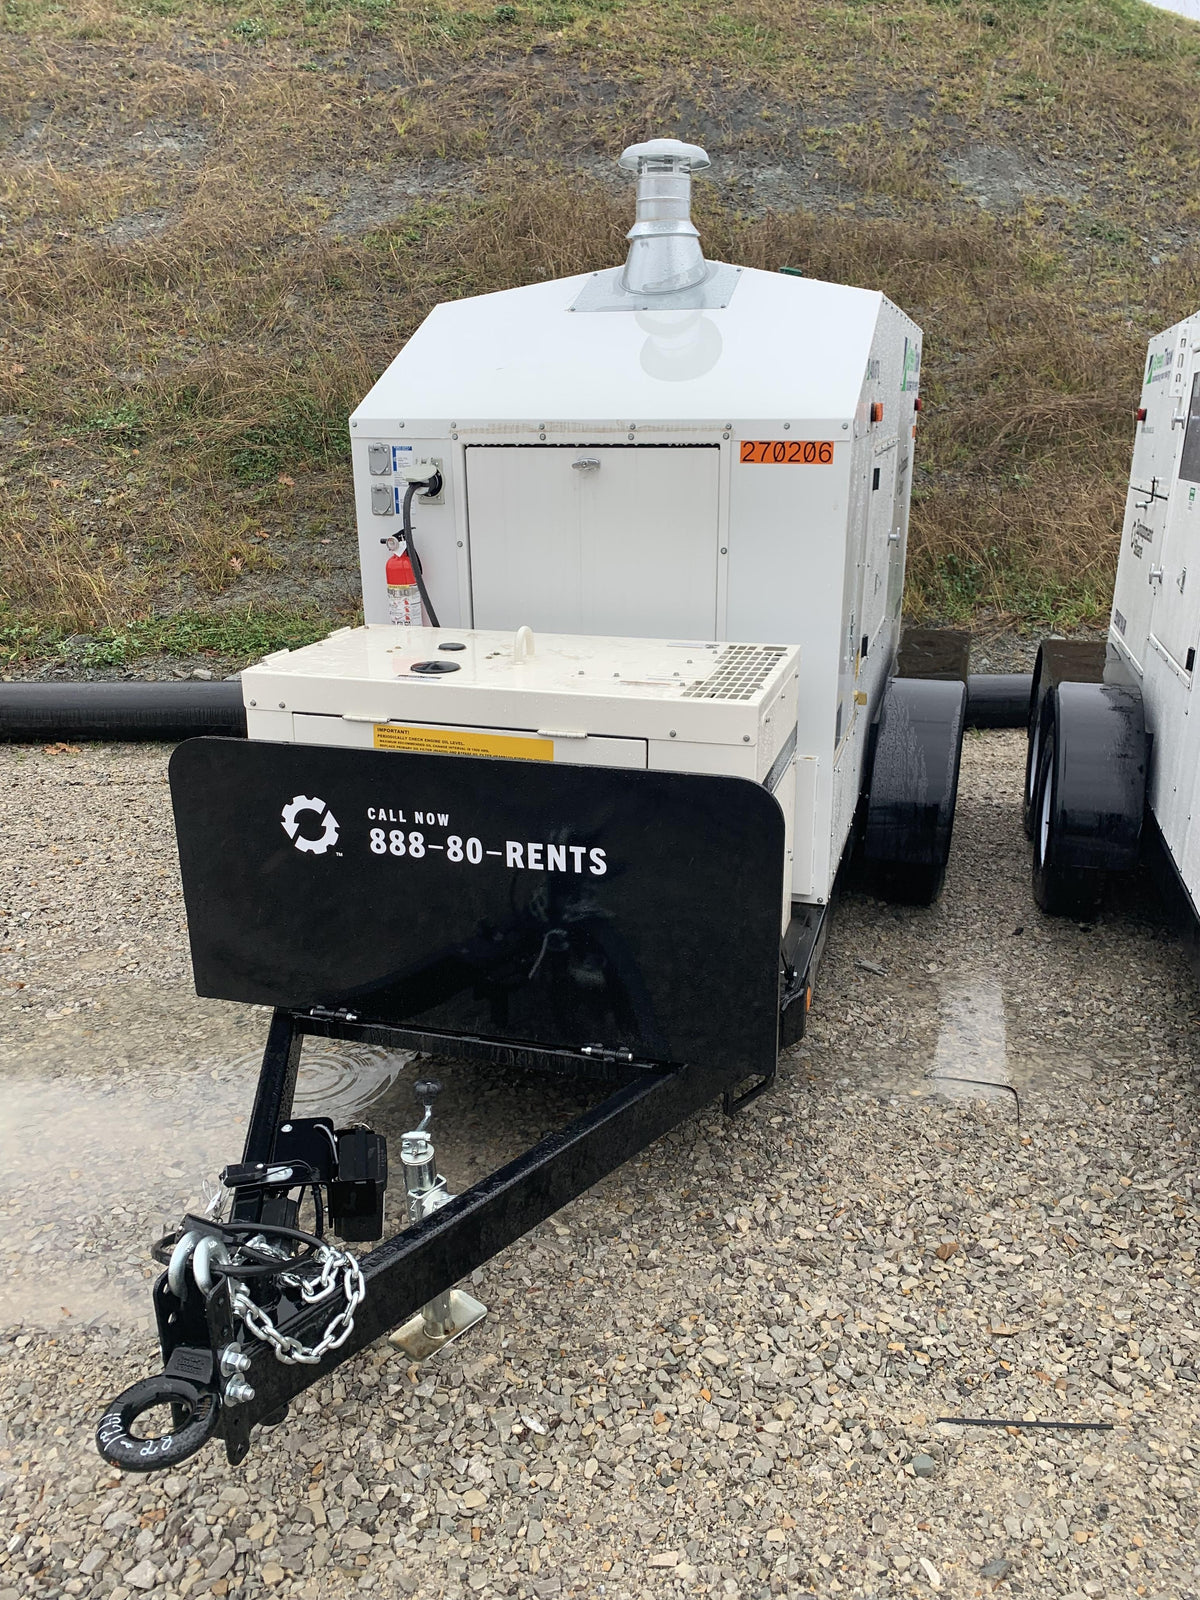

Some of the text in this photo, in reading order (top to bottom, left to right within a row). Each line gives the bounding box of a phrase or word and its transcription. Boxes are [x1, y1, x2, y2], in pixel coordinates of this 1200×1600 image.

[742, 441, 832, 463] 270206
[377, 727, 410, 735] IMPORTANT!
[367, 807, 449, 827] CALL NOW
[369, 827, 607, 876] 888-80-RENTS
